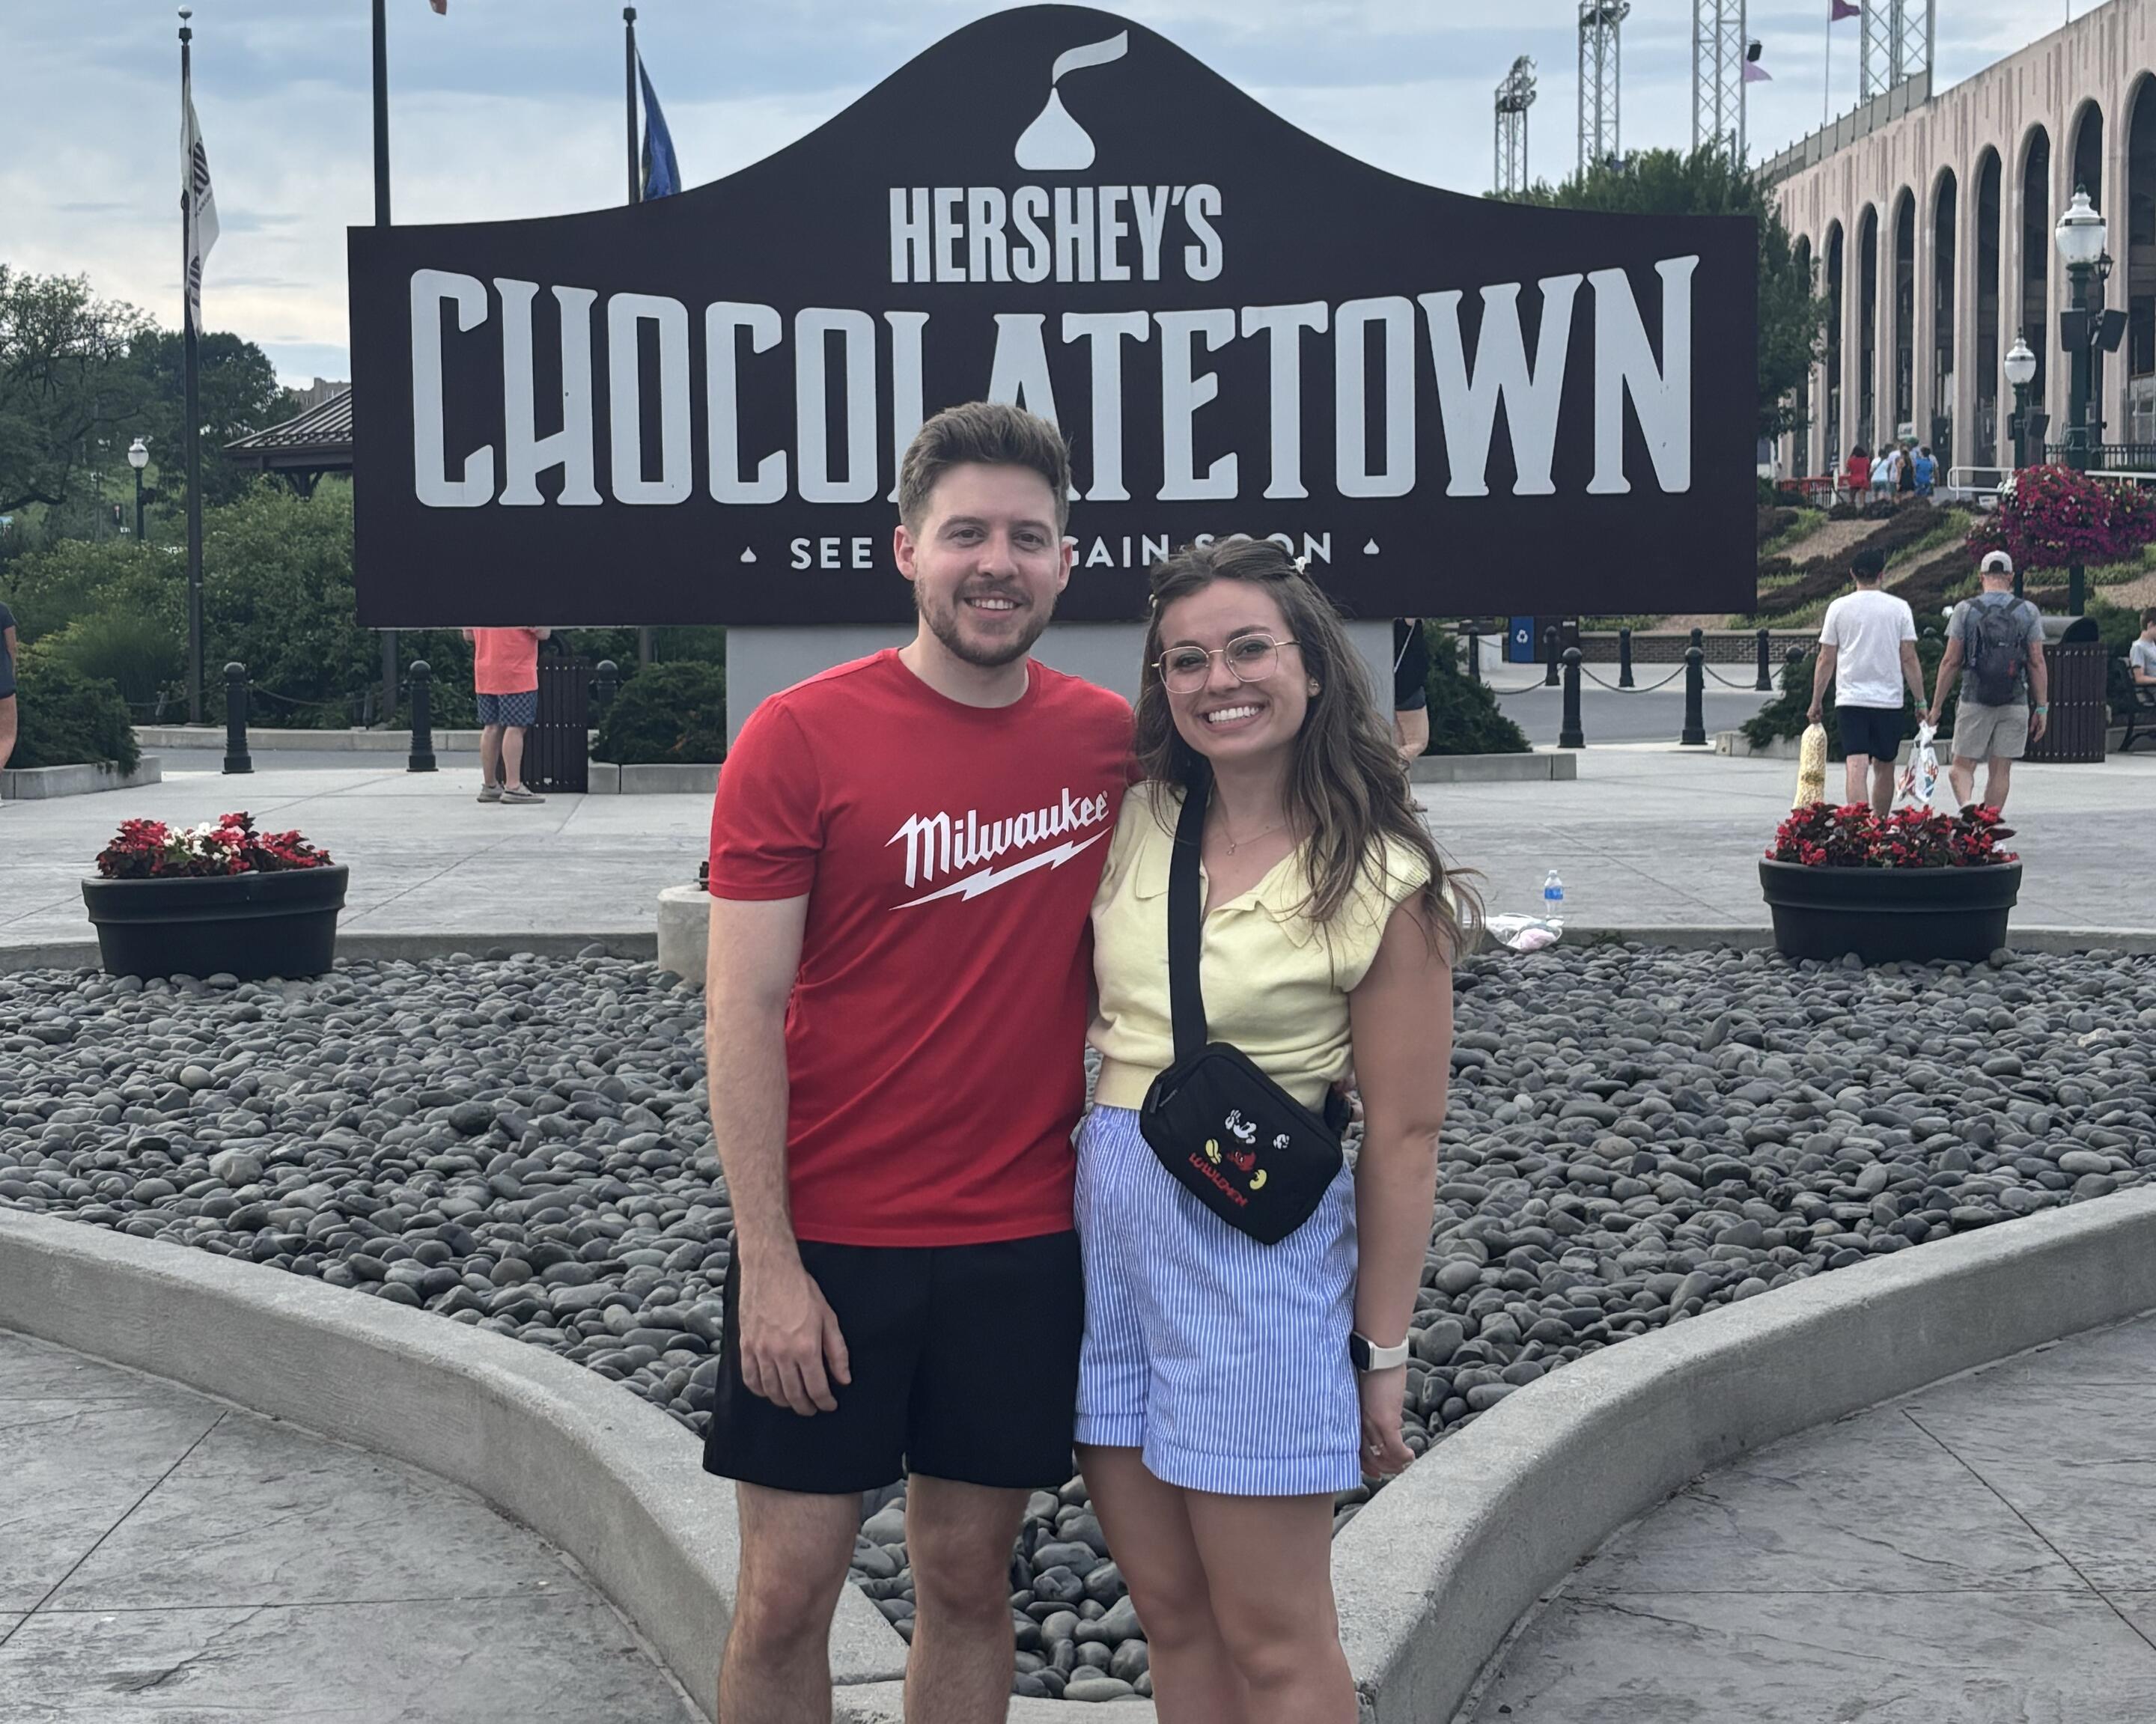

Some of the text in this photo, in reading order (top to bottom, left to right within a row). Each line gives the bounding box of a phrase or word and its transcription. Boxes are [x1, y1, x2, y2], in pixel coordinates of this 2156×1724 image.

[889, 184, 1224, 284] HERSHEY'S
[410, 255, 1700, 509] CHOCOLATETOWN
[790, 536, 874, 570] SEE
[884, 788, 1110, 889] Milwaukee
